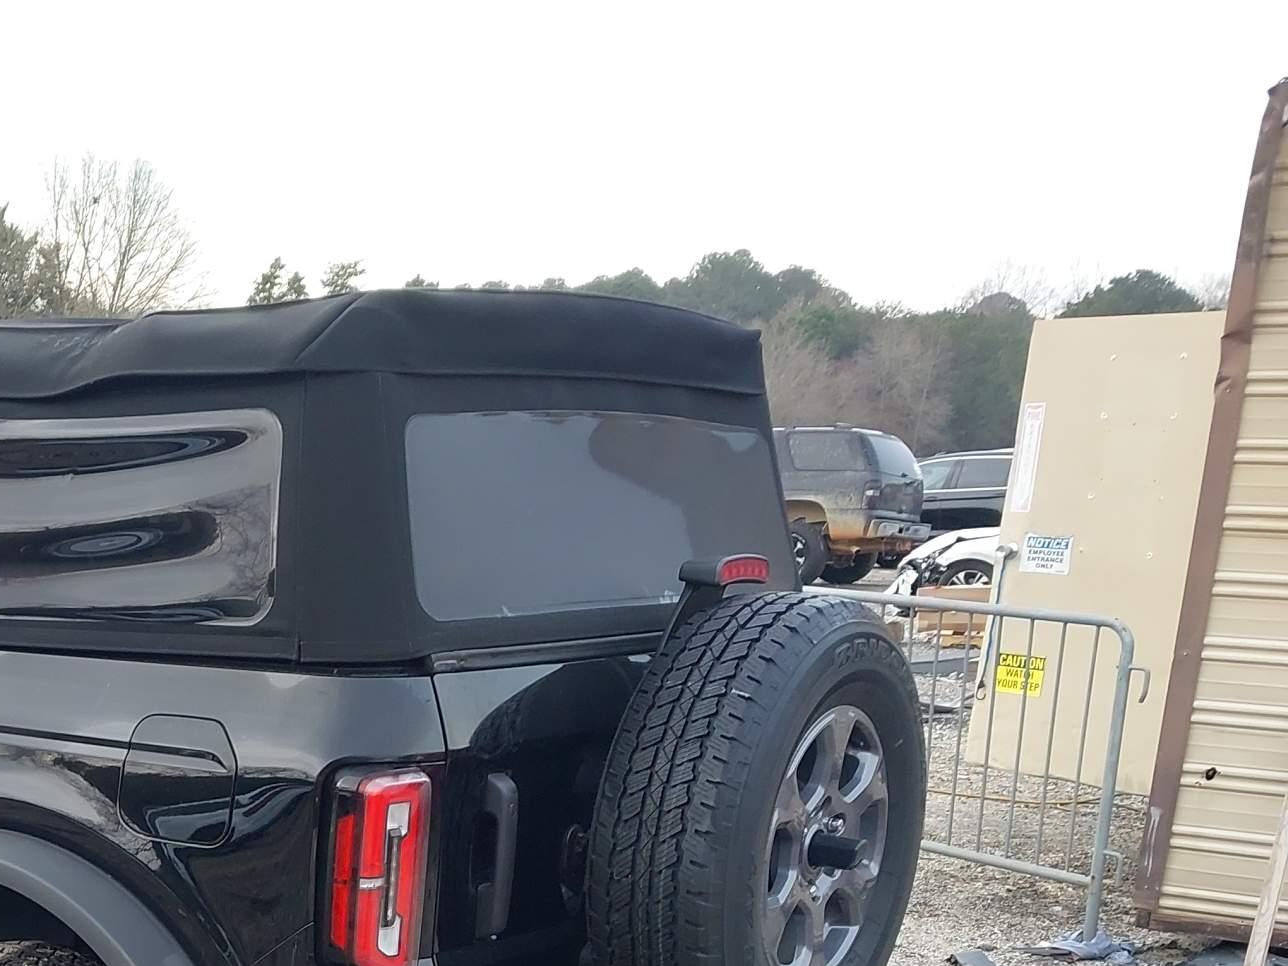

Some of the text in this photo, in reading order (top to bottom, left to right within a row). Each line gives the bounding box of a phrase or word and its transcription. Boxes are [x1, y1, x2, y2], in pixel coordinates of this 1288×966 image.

[1027, 536, 1069, 549] NOTICE
[1028, 549, 1064, 557] EMPLOYEE
[1000, 654, 1044, 669] CAUTON
[998, 679, 1040, 691] YOUR SEP
